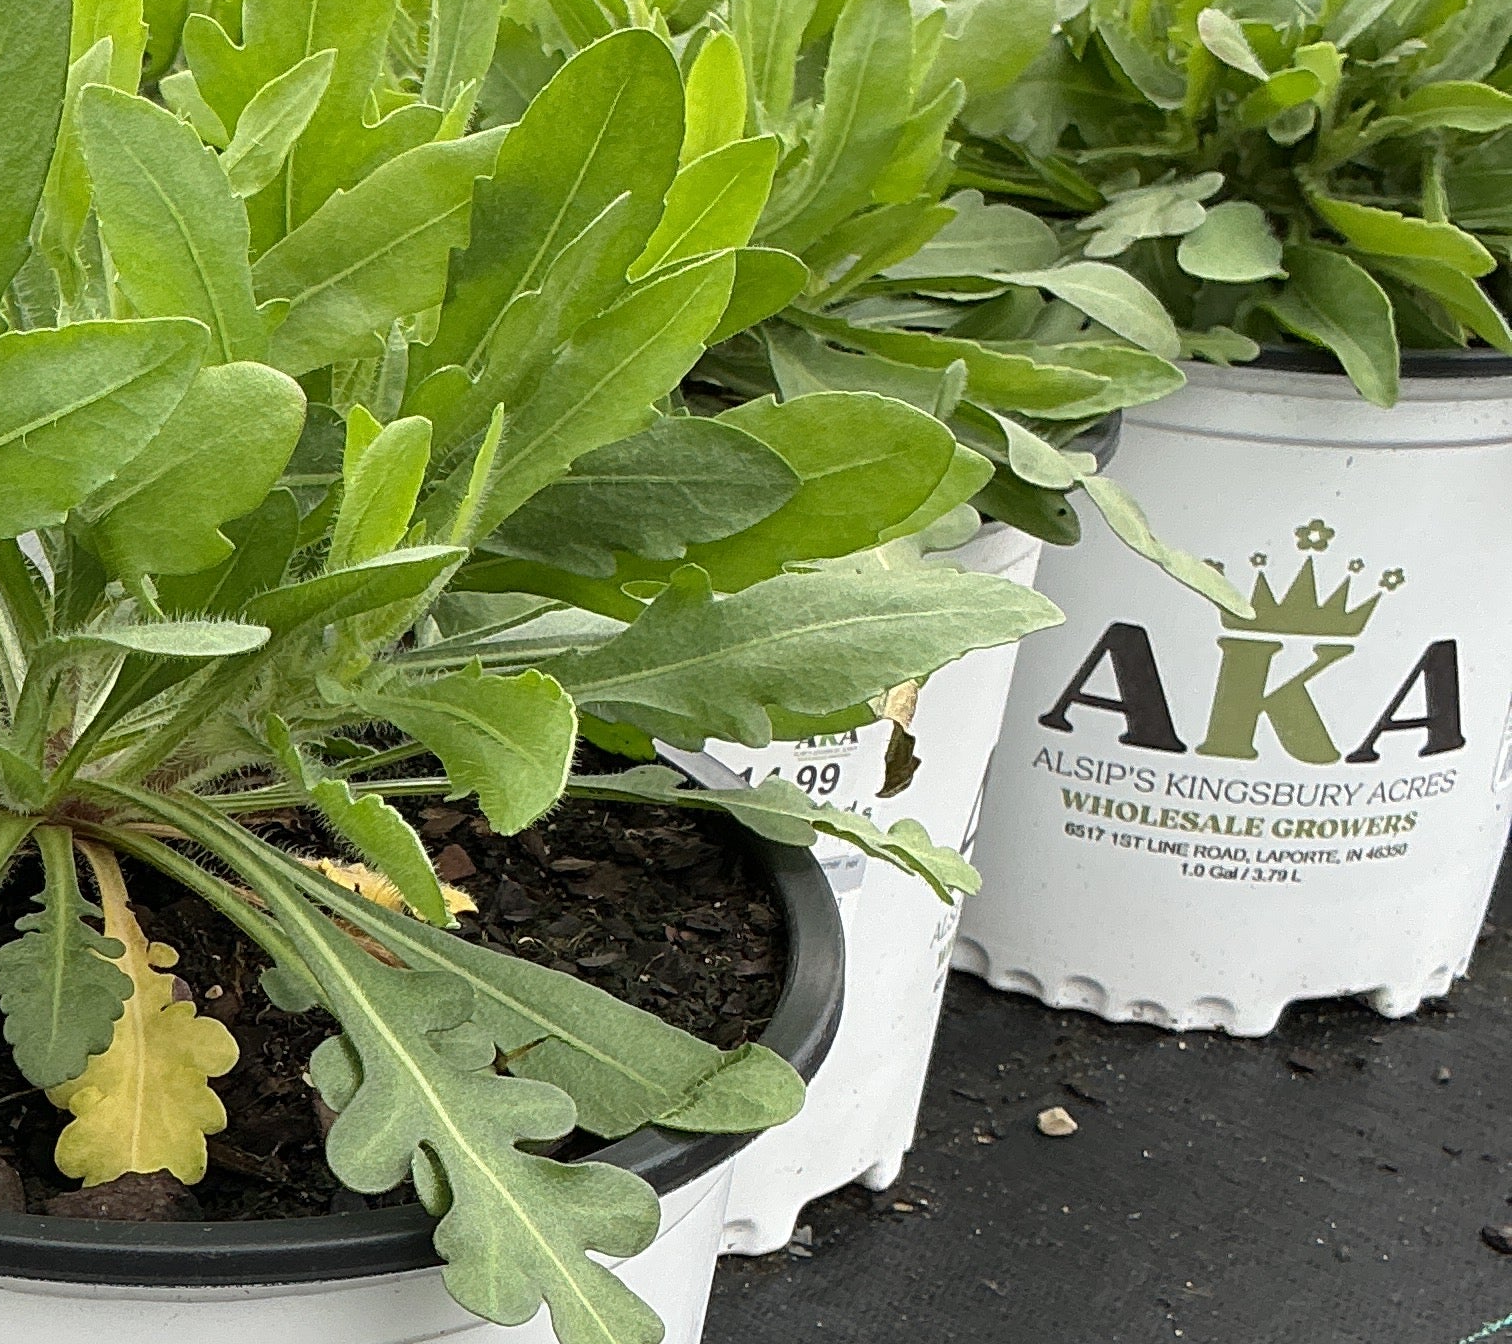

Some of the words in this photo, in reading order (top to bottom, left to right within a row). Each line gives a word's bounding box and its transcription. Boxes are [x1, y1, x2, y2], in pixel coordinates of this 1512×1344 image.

[1037, 621, 1467, 766] AKA
[1032, 746, 1157, 793] ALSIP'S
[1165, 772, 1364, 807] KINGSBURY
[1366, 768, 1457, 805] ACRES
[1060, 787, 1265, 838] WHOLESALE
[1271, 809, 1419, 839] GROWERS
[1064, 821, 1106, 842] 6517
[1112, 832, 1146, 850] 1ST
[1147, 837, 1190, 857] LINE
[1346, 847, 1364, 862] IN
[1181, 862, 1205, 878] 1.0
[1208, 864, 1238, 880] Gal
